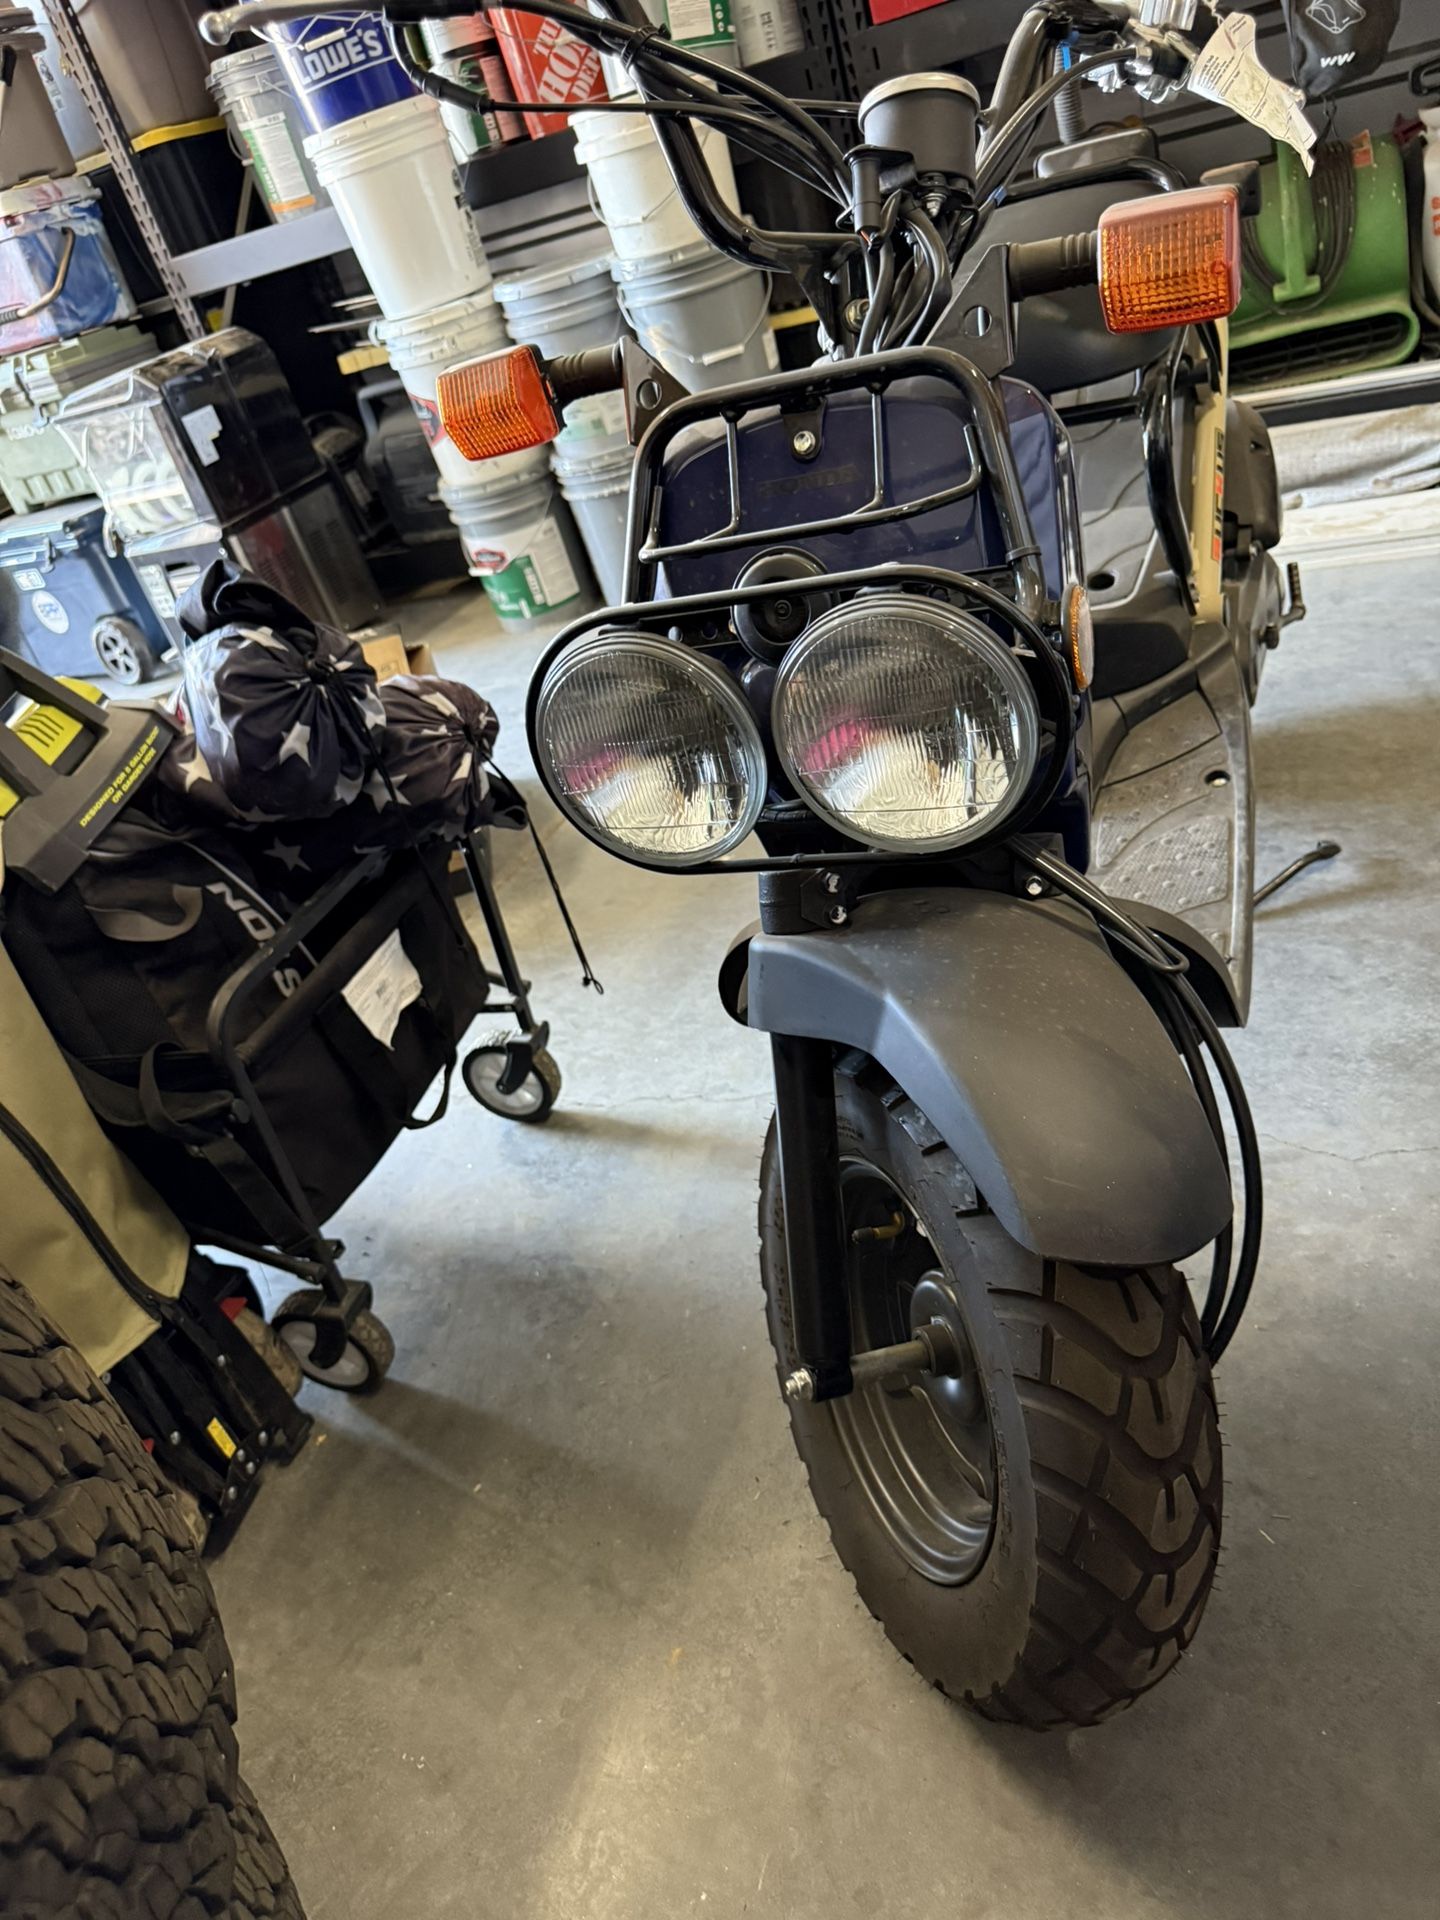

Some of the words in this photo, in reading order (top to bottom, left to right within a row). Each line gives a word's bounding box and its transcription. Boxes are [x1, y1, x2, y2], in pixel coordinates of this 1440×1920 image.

[292, 28, 384, 86] LOWE'S
[570, 47, 600, 100] DEP
[111, 789, 124, 804] OR
[112, 771, 128, 789] FOR
